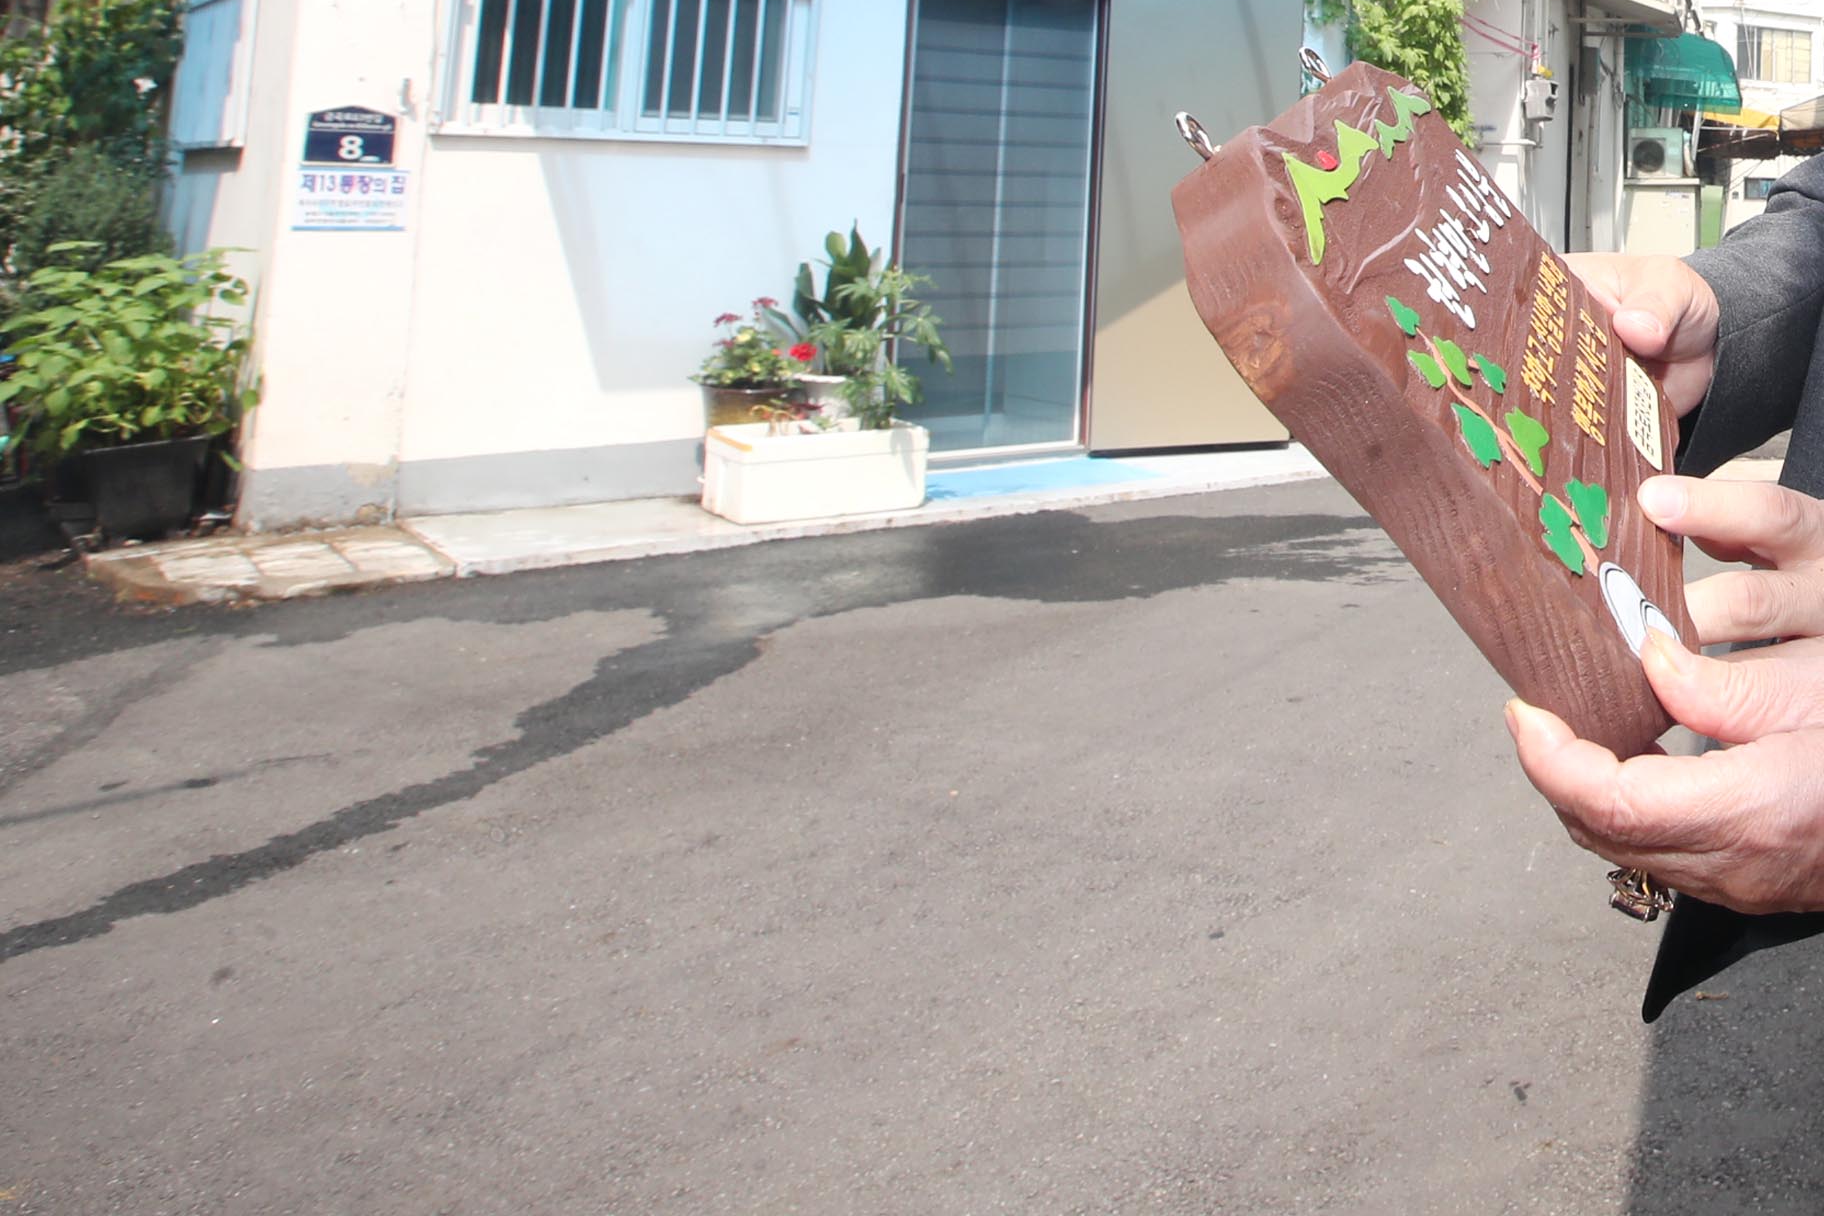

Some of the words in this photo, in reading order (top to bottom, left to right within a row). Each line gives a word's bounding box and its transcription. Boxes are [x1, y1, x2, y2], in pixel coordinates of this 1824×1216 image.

[338, 134, 364, 160] 8
[1530, 289, 1564, 354] 성실한
[1579, 308, 1607, 345] 집
[1520, 334, 1557, 405] 착하고
[1576, 330, 1606, 372] 사는
[1571, 355, 1605, 446] 행복하게
